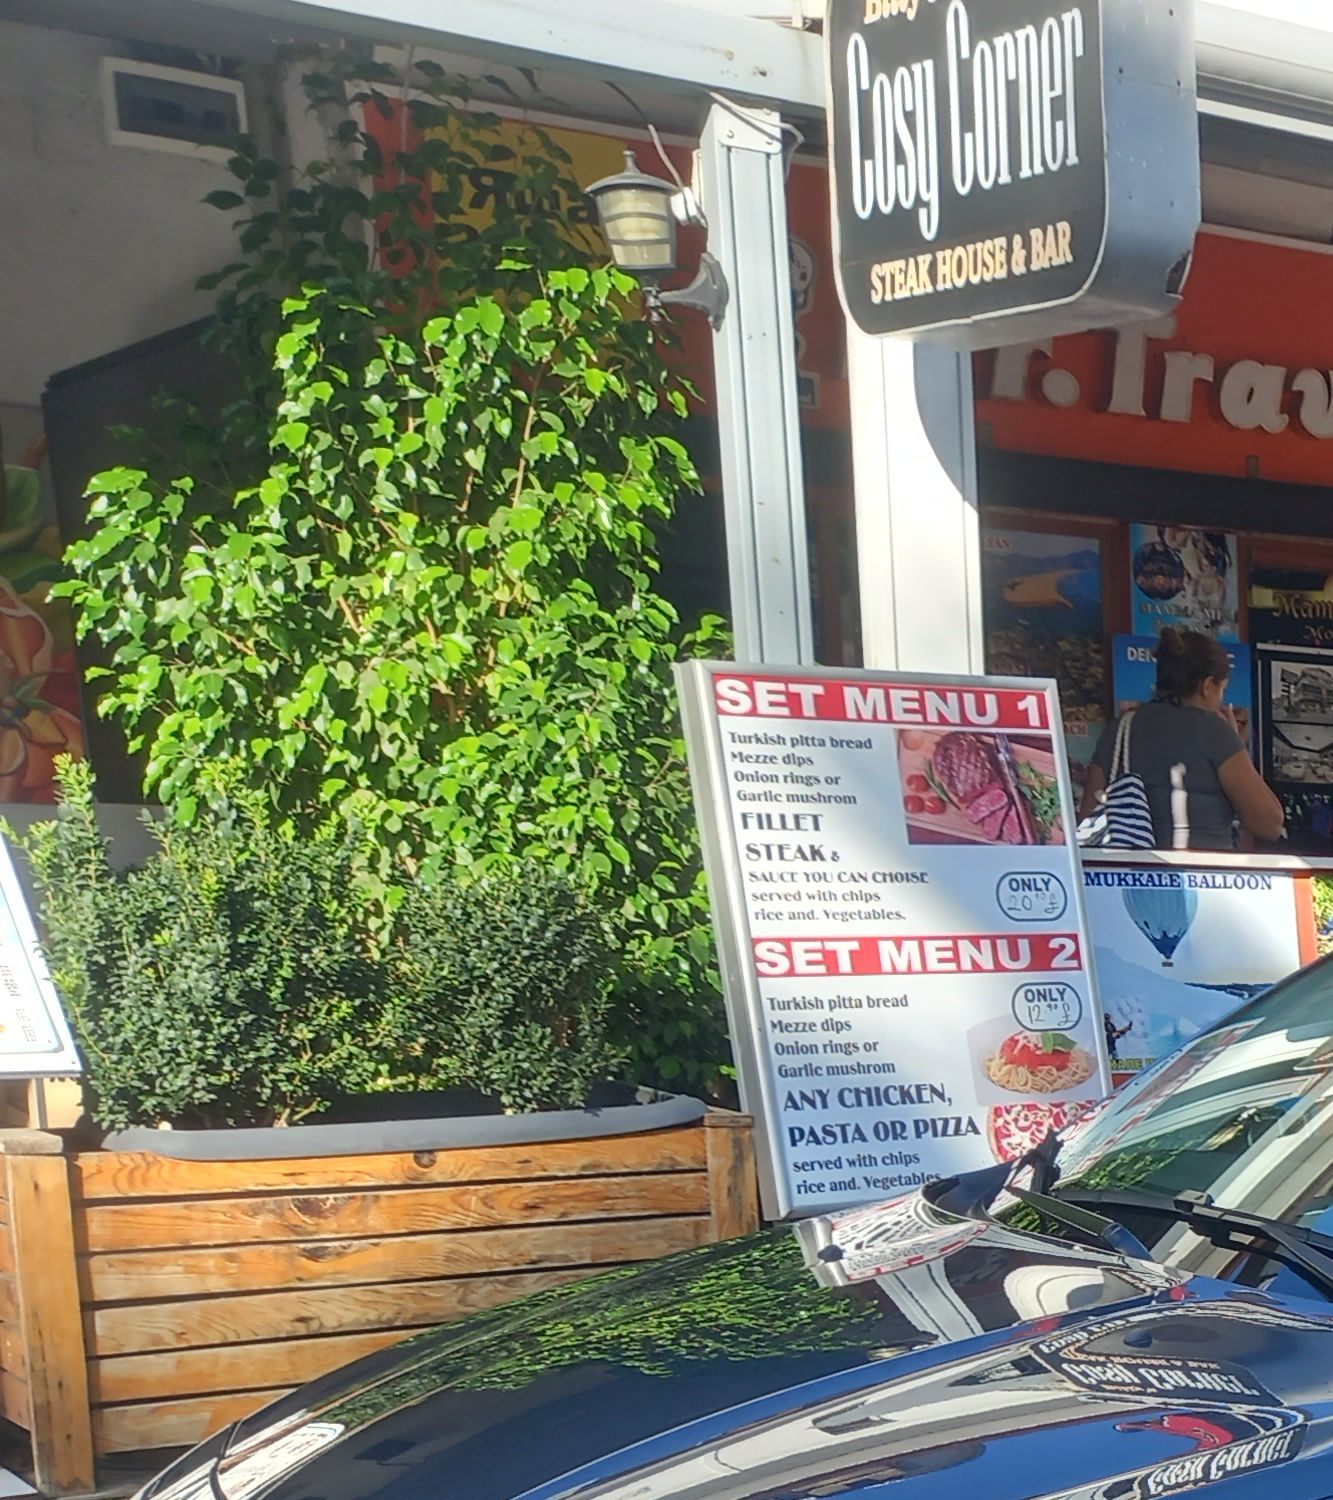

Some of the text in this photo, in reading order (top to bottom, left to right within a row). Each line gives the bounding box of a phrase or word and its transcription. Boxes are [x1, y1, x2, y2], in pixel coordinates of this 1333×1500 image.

[846, 0, 1084, 242] Cosy Corner
[870, 220, 1074, 304] STEAK HOUSE & BAR
[715, 679, 1039, 727] SET MENU 1
[728, 731, 872, 749] Turkish pitta bread
[731, 752, 814, 767] Mezze dips
[734, 770, 841, 787] Onion rings or
[736, 789, 857, 804] Garlic mushrom
[741, 812, 823, 832] FILLET
[746, 843, 827, 862] STEAK
[749, 871, 800, 884] SAUCE
[803, 871, 833, 883] YOU
[837, 872, 869, 883] CAN
[1008, 877, 1051, 892] ONLY
[1187, 873, 1273, 891] BALLOON
[752, 890, 880, 904] served with chips
[754, 909, 783, 921] rice
[788, 909, 819, 921] and.
[755, 938, 1078, 975] SET MENU 2
[767, 994, 908, 1012] Turkish pitta bread
[1024, 988, 1066, 1003] ONLY
[771, 1018, 851, 1034] Mezze dips
[774, 1040, 879, 1056] Onion rings or
[778, 1062, 895, 1079] Garlic mushrom
[783, 1083, 953, 1112] ANY CHICKEN,
[788, 1116, 981, 1148] PASTA OR PIZZA
[793, 1152, 920, 1173] served with chips
[796, 1180, 825, 1195] rice
[830, 1176, 861, 1192] and.
